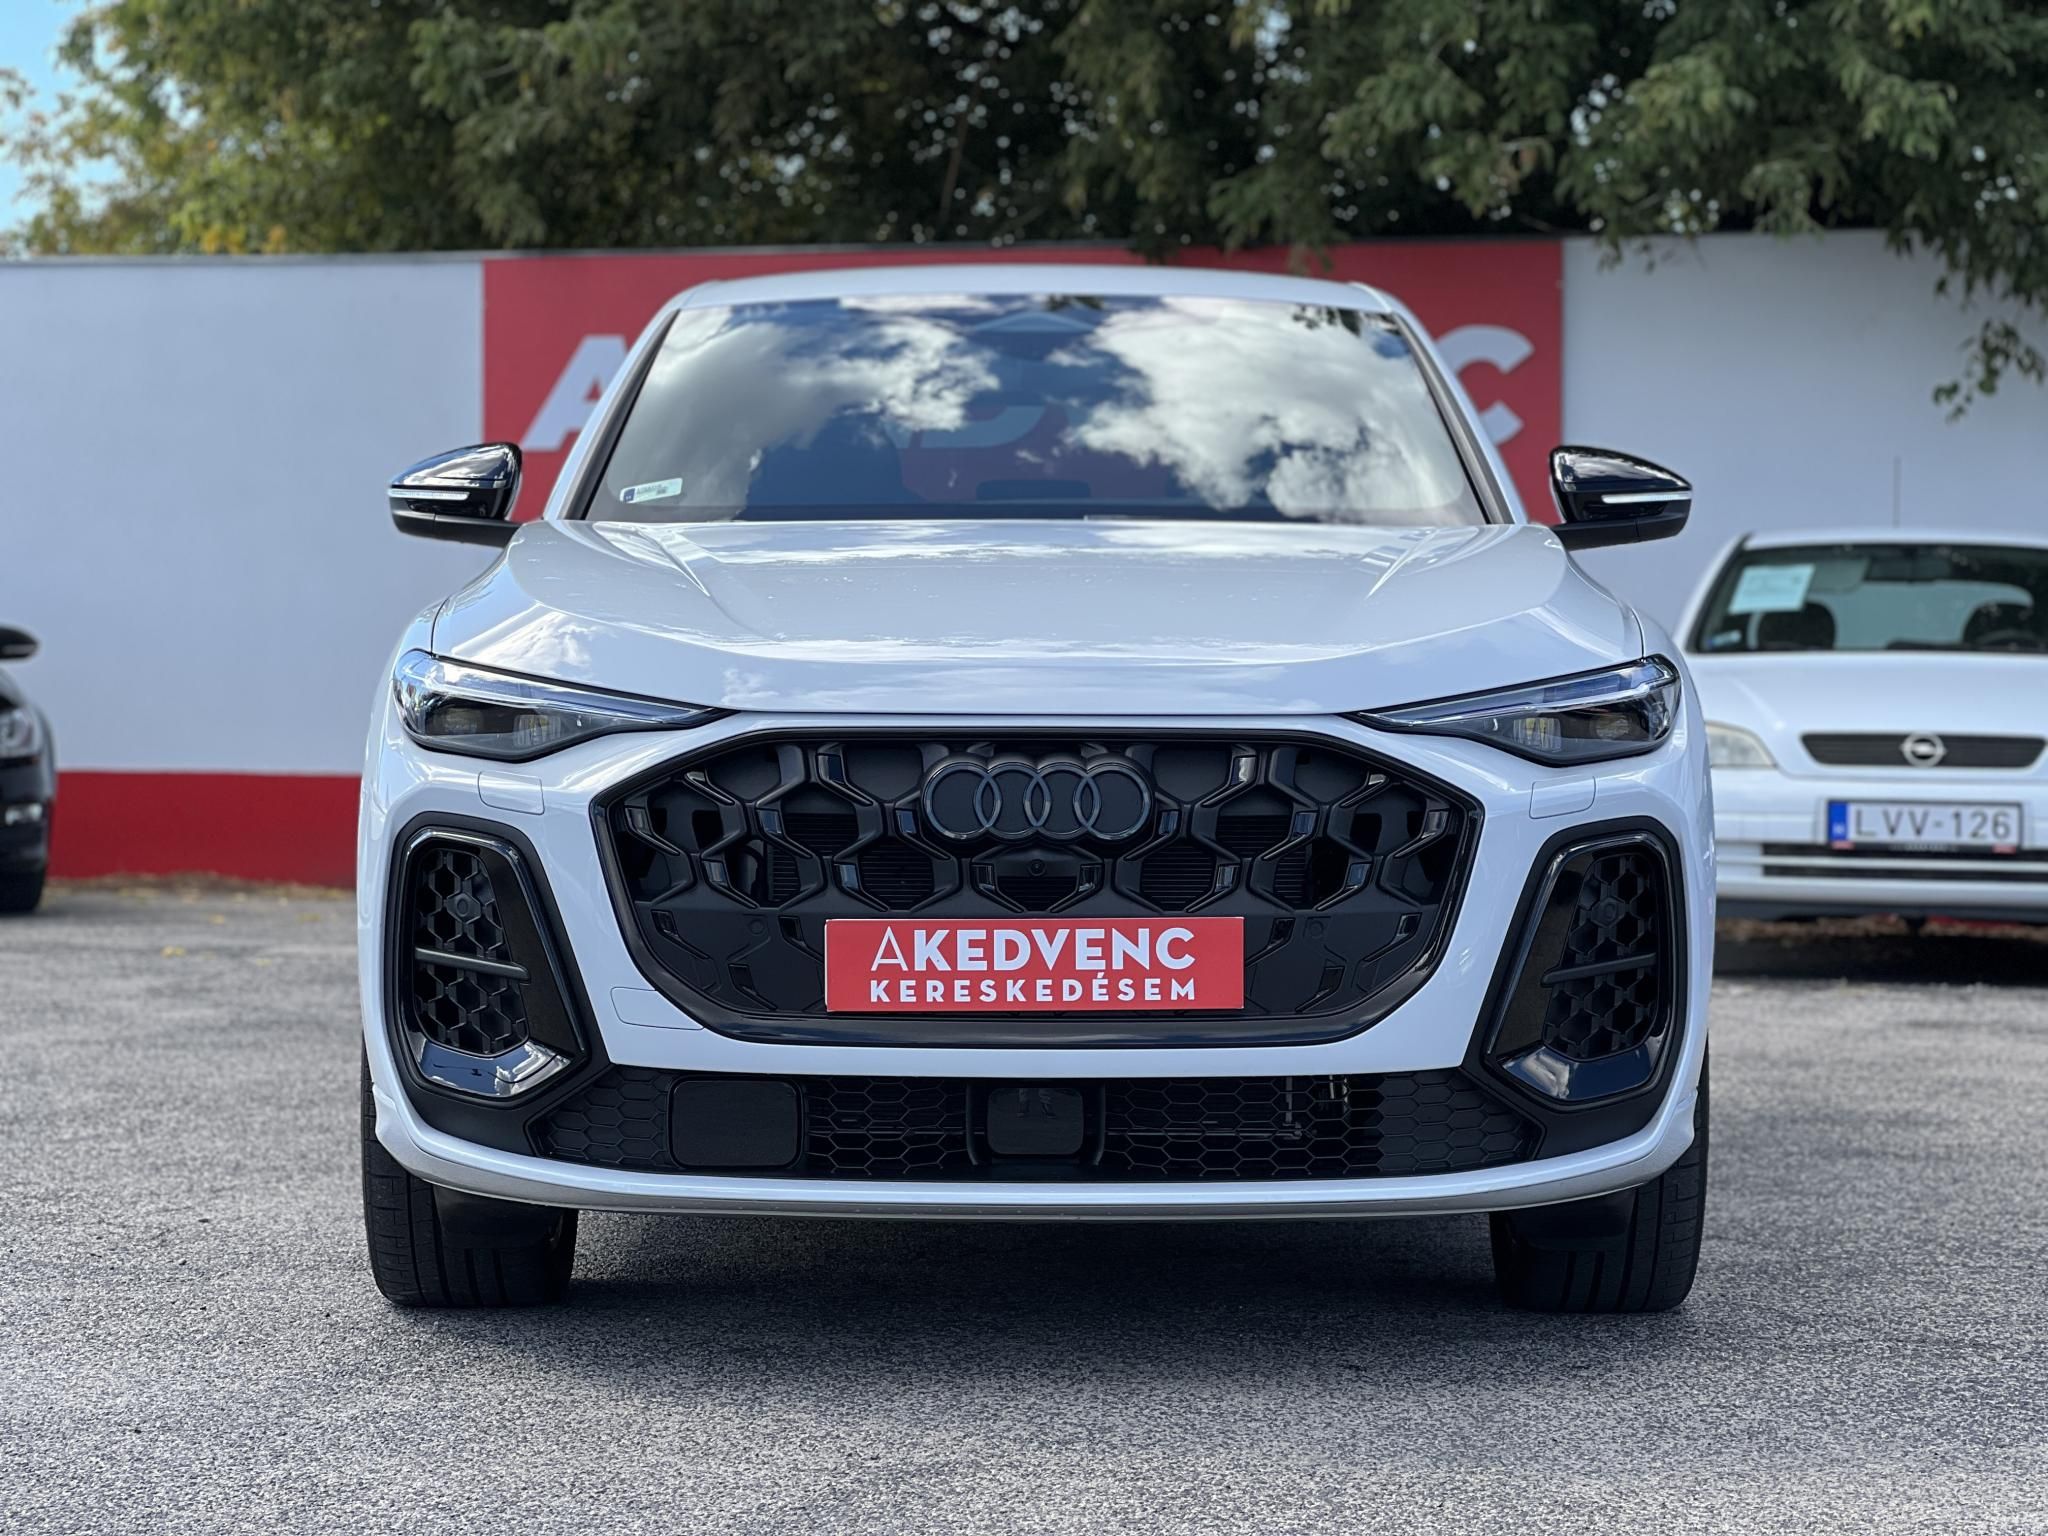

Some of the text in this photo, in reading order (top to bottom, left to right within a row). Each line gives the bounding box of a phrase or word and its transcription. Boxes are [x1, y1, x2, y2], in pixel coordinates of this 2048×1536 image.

[1855, 809, 2012, 840] LVV-126
[870, 925, 1196, 971] AKEDVENC
[870, 972, 1196, 1002] KERESKEDÉSEM
